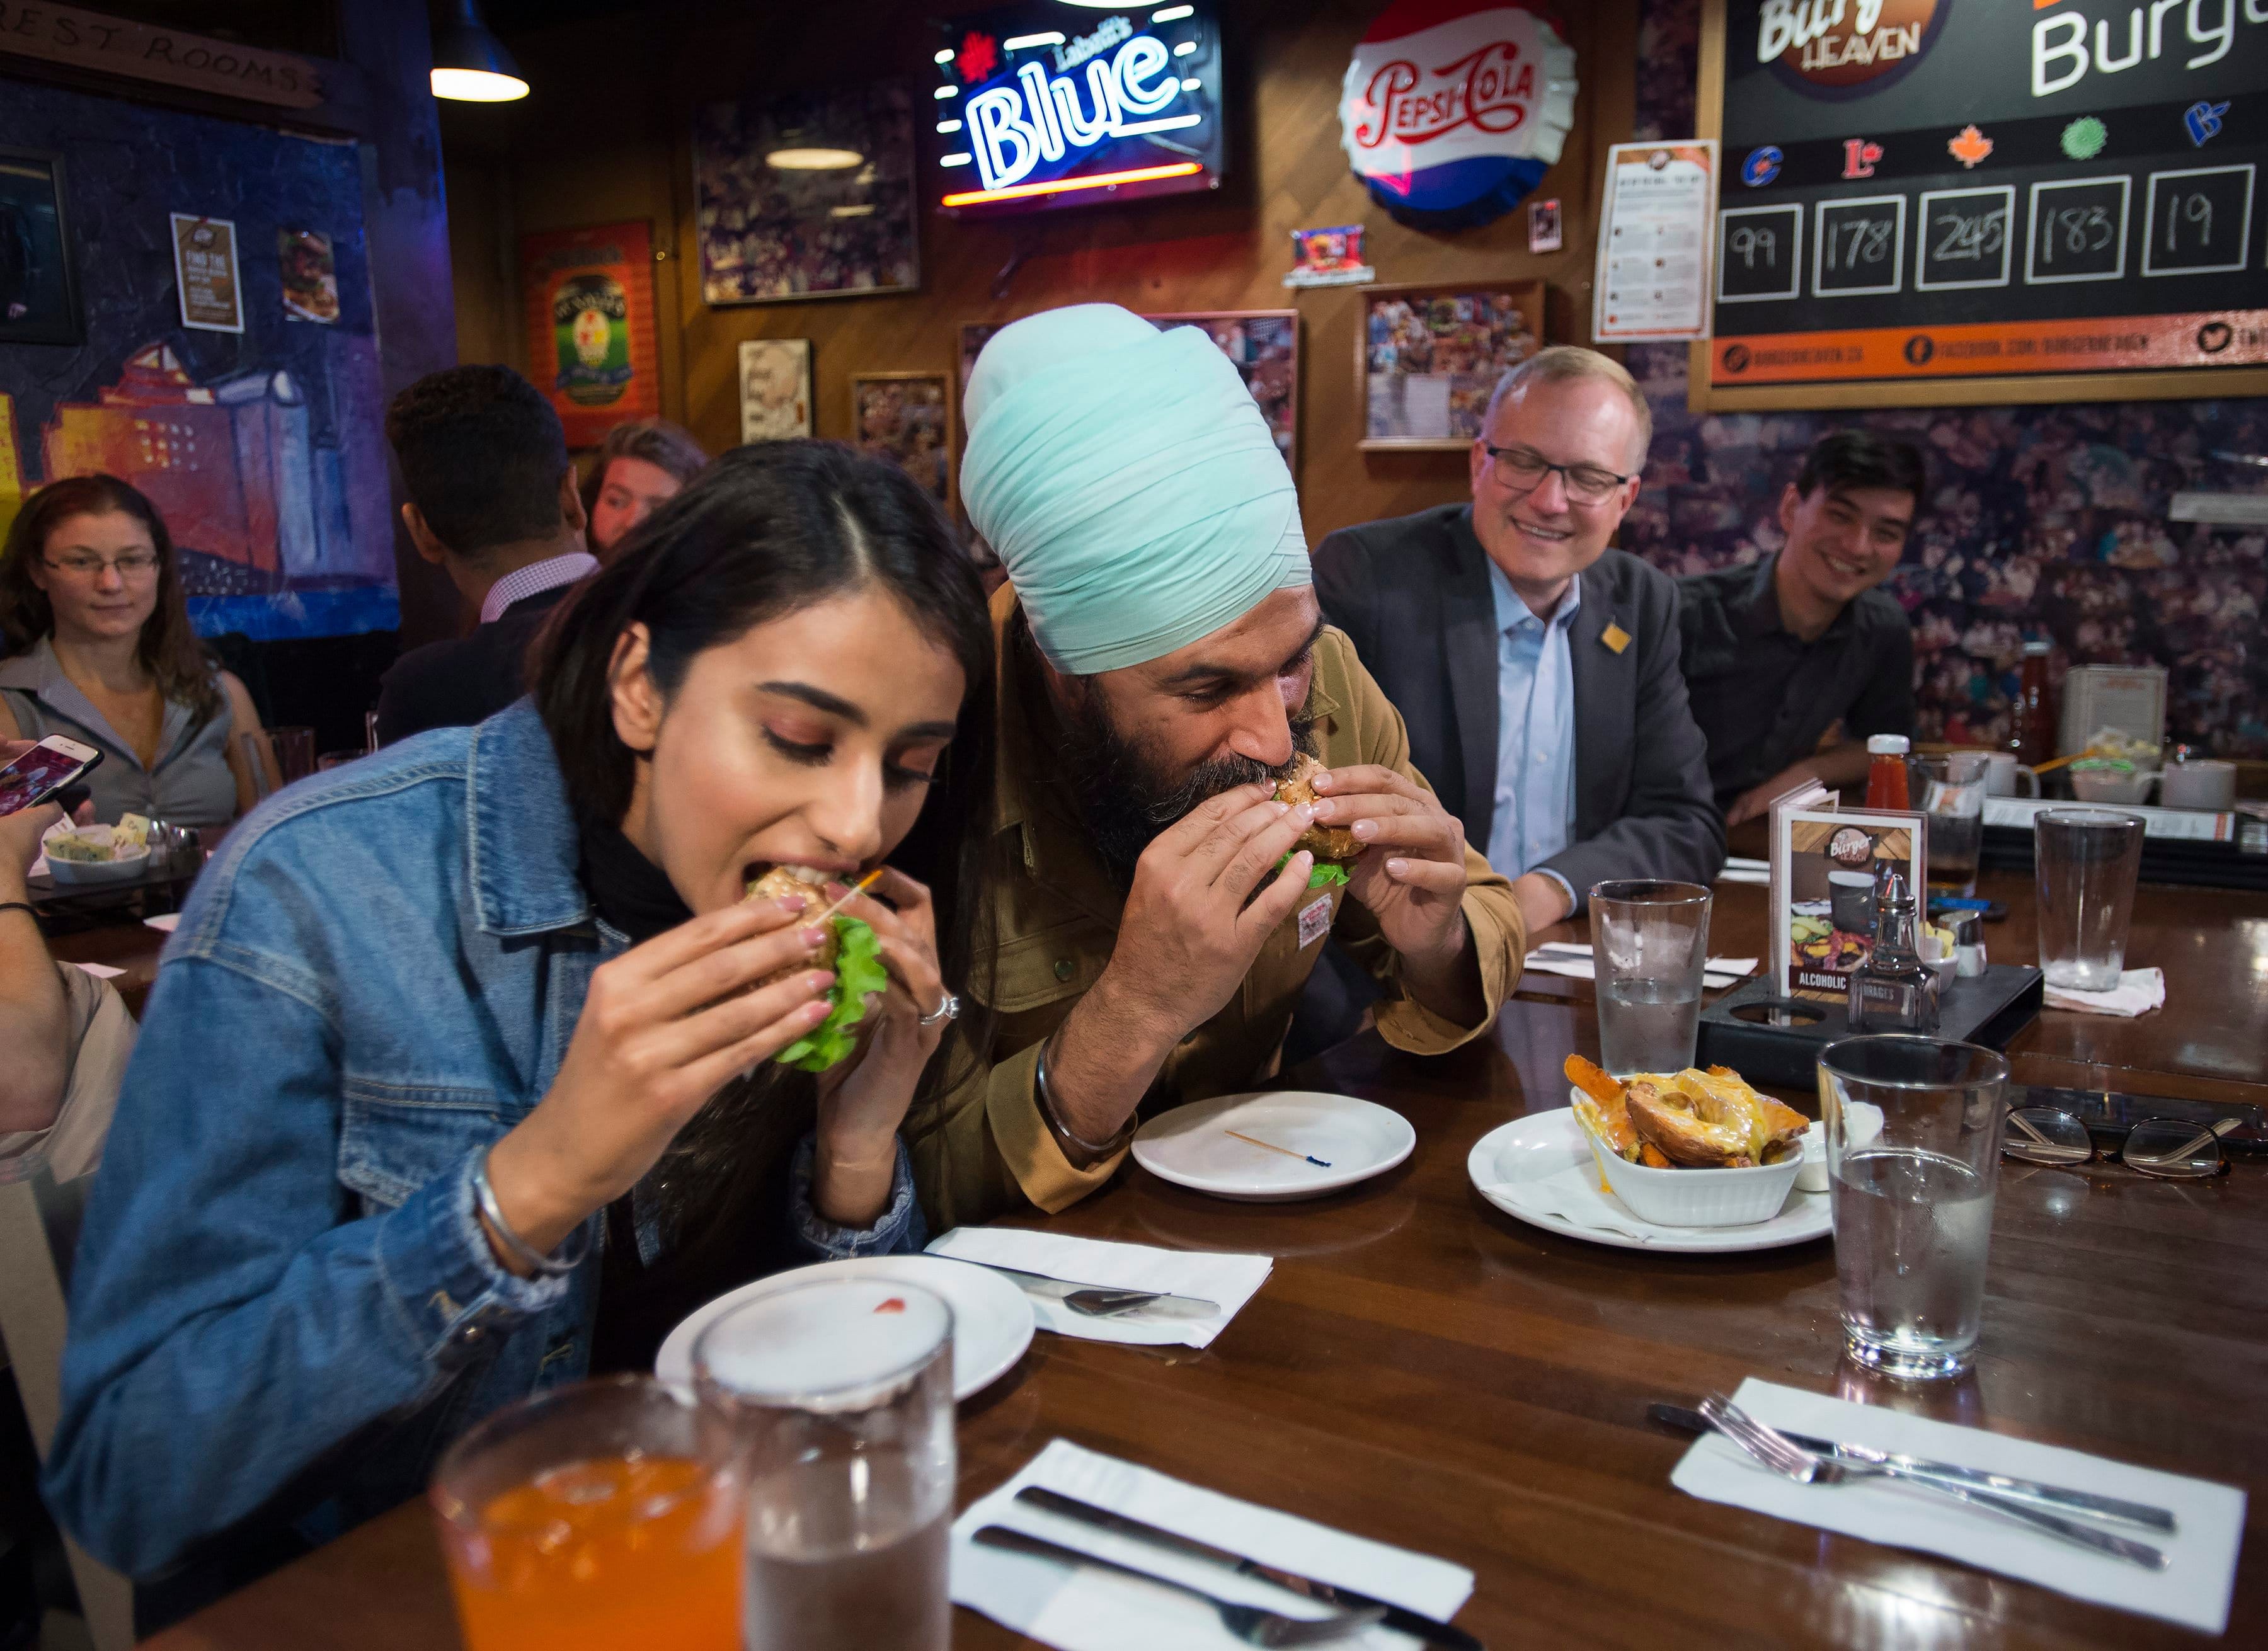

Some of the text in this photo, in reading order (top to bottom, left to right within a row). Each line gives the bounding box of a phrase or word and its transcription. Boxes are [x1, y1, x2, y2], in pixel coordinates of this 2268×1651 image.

[143, 35, 300, 92] ROOMS
[965, 36, 1181, 191] Blue
[1729, 227, 1776, 269] 99
[1827, 218, 1893, 271] 178
[2042, 206, 2114, 264] 183
[2167, 193, 2213, 251] 19
[1830, 836, 1872, 857] Burger
[1799, 972, 1847, 990] ALCOHOLIC
